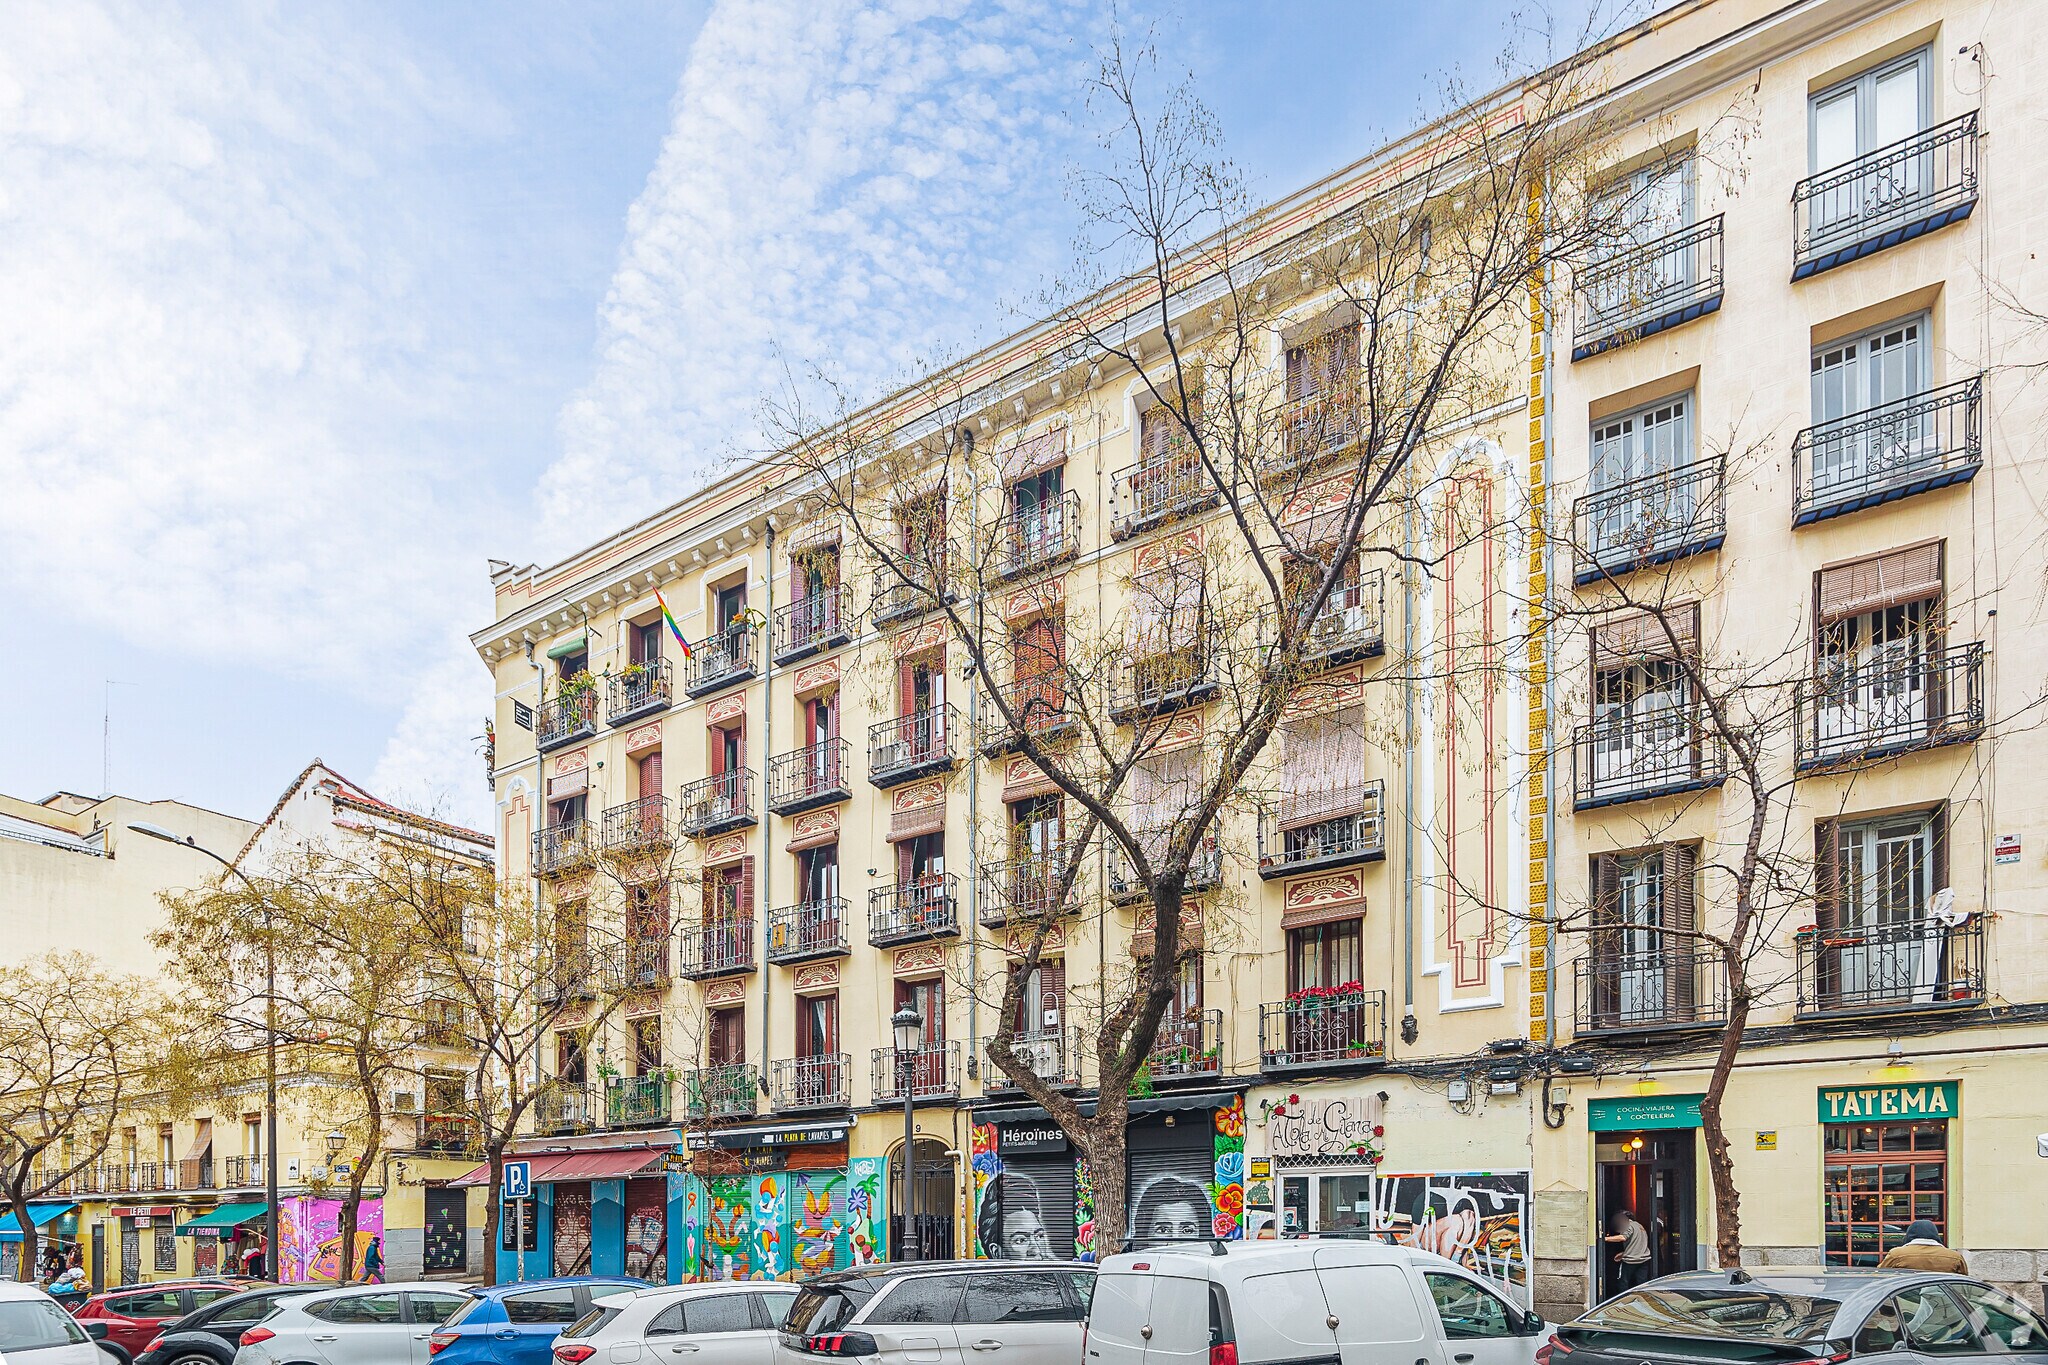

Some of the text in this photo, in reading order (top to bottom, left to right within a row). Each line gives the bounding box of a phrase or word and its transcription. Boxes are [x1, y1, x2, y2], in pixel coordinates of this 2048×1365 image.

[1825, 1087, 1948, 1116] TATEMA
[915, 1124, 921, 1132] 9
[775, 1134, 782, 1143] LA
[783, 1132, 799, 1143] PLAYA
[800, 1132, 807, 1142] DE
[1002, 1128, 1064, 1142] Héroïnes
[511, 1165, 521, 1193] P
[130, 1207, 151, 1215] LE PETIT
[187, 1227, 195, 1236] LA
